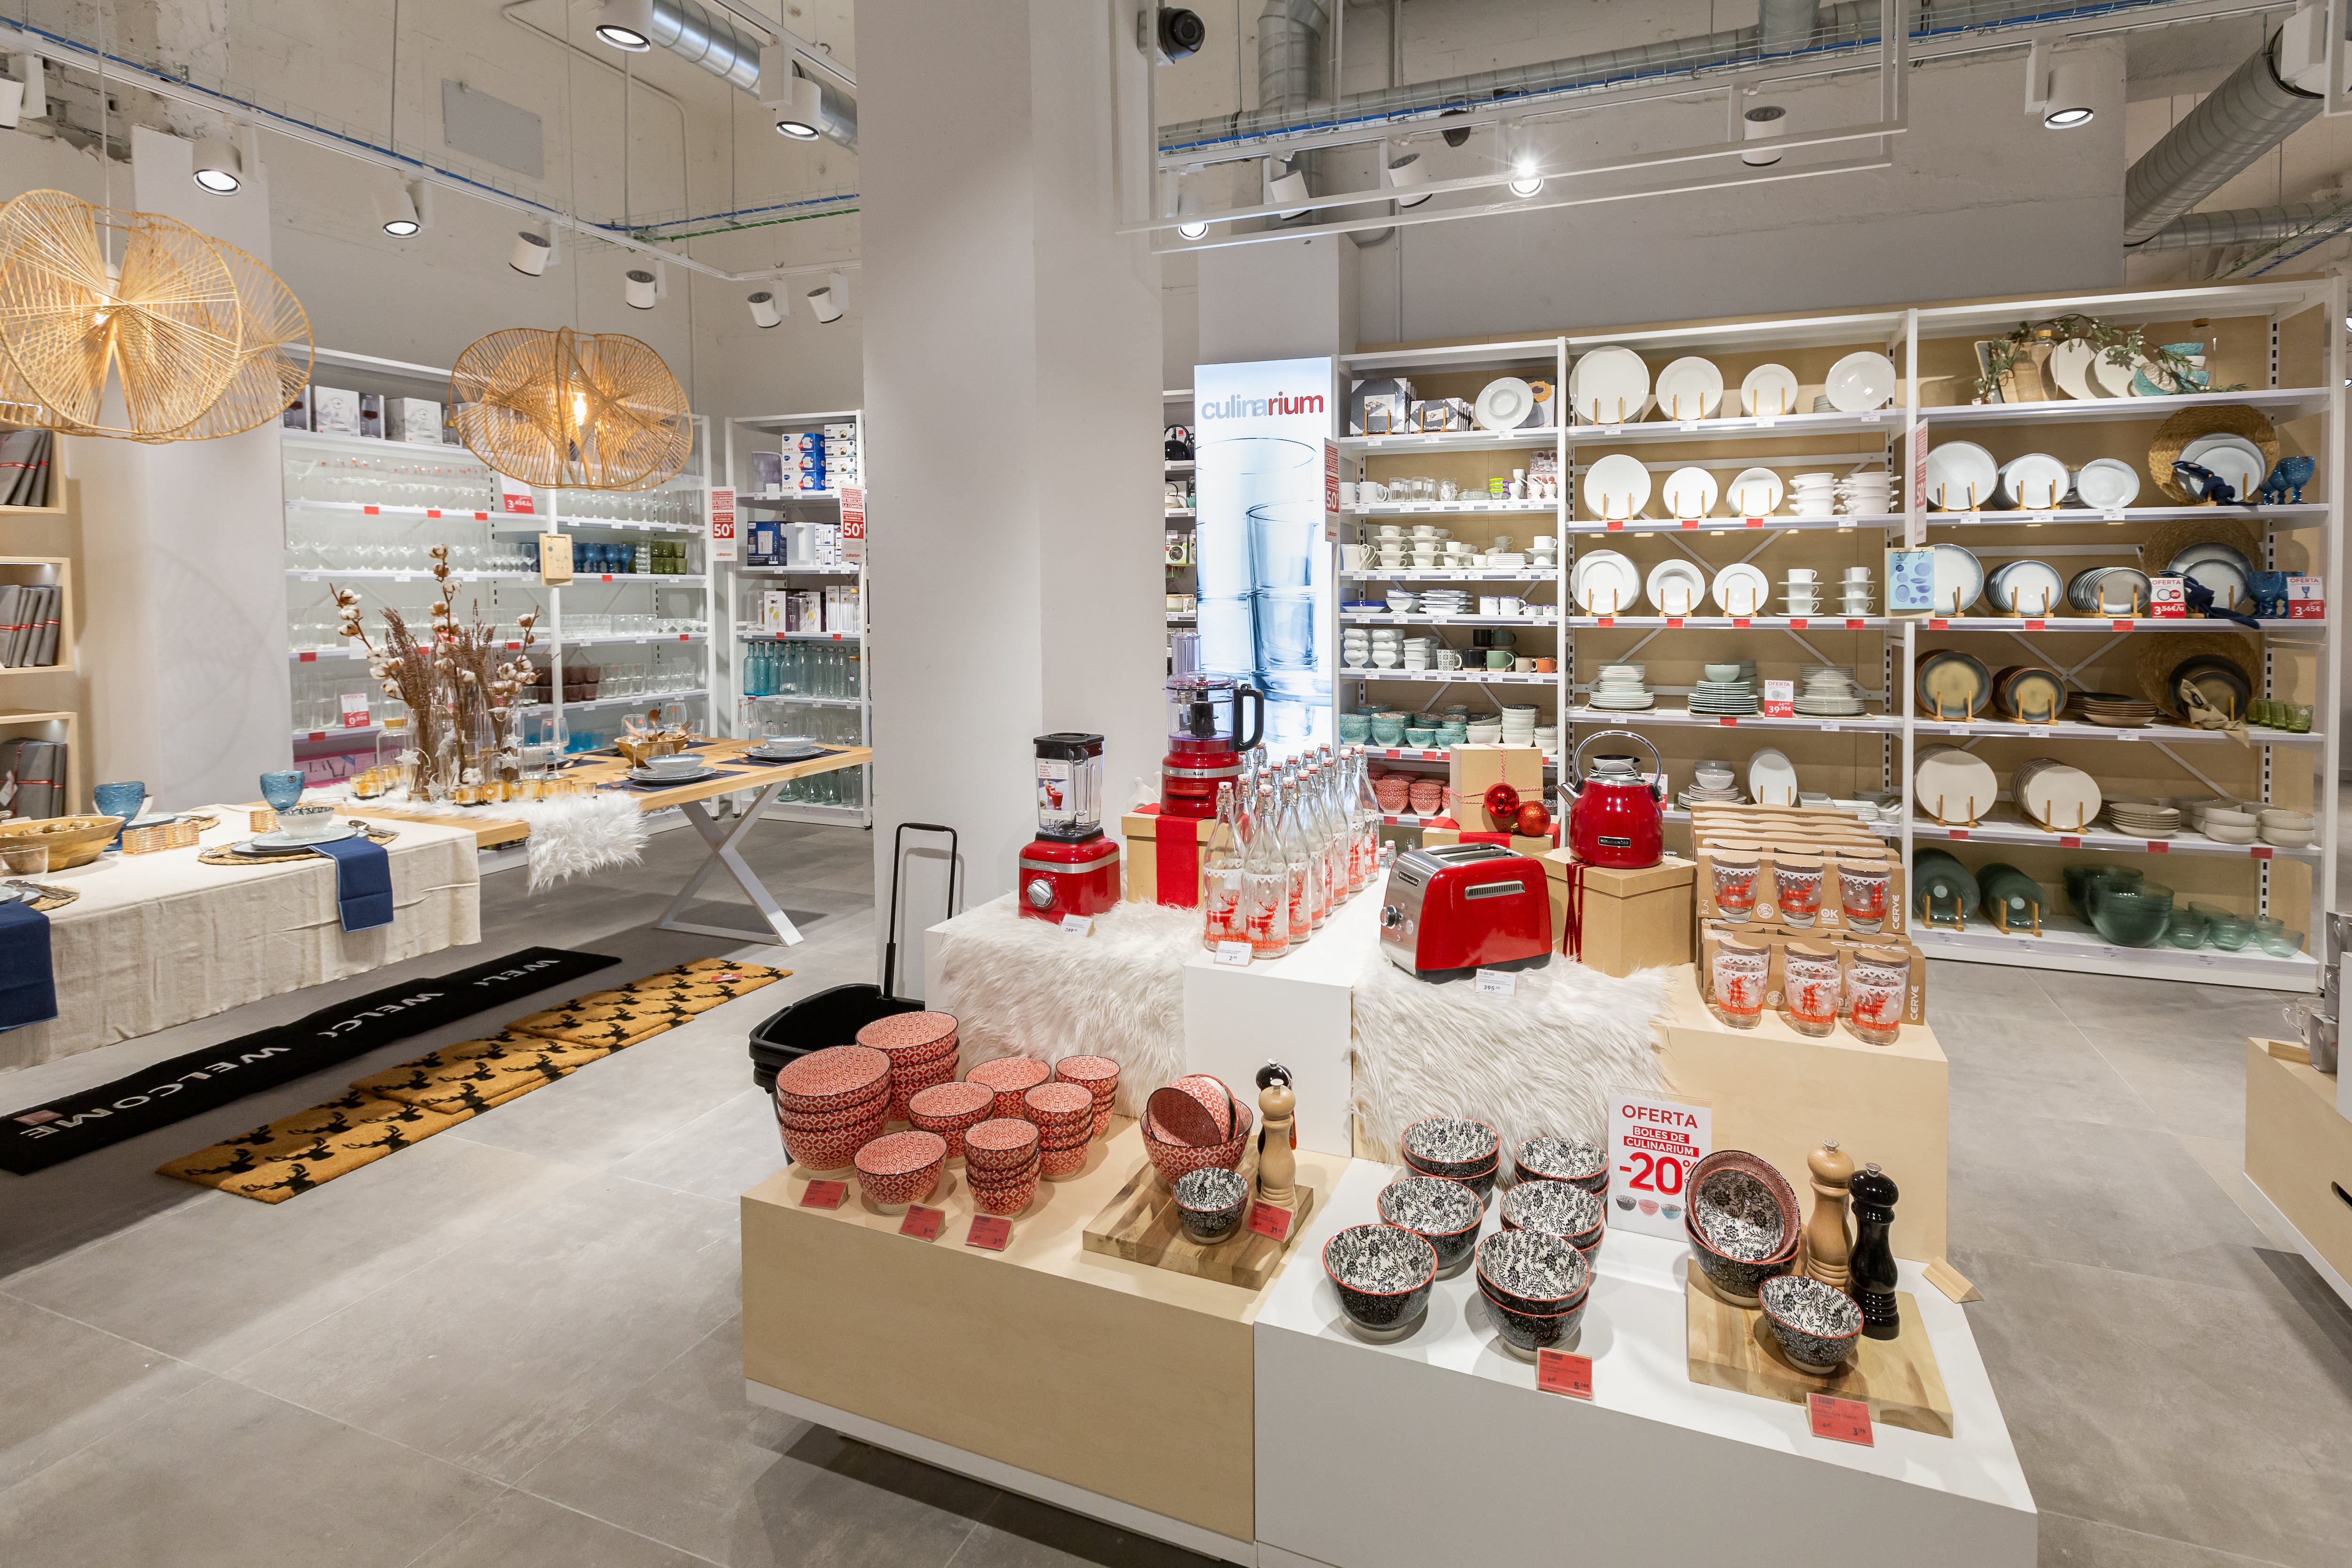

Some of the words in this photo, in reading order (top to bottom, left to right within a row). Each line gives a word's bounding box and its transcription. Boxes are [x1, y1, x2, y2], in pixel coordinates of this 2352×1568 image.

[1201, 391, 1323, 420] culinarium
[714, 523, 734, 537] 50€
[844, 522, 864, 537] 50€
[2154, 605, 2184, 615] 3.56€/u
[2295, 606, 2321, 616] 3.45€
[1701, 899, 1709, 911] 3
[1821, 908, 1839, 918] OK
[1830, 941, 1907, 952] CERVE
[1910, 985, 1919, 1020] CERVE
[19, 1046, 292, 1139] WELCOME
[1622, 1105, 1698, 1129] OFERTA
[1634, 1127, 1668, 1140] BOLES
[1670, 1133, 1685, 1143] DE
[1626, 1138, 1694, 1156] CULINARIUM
